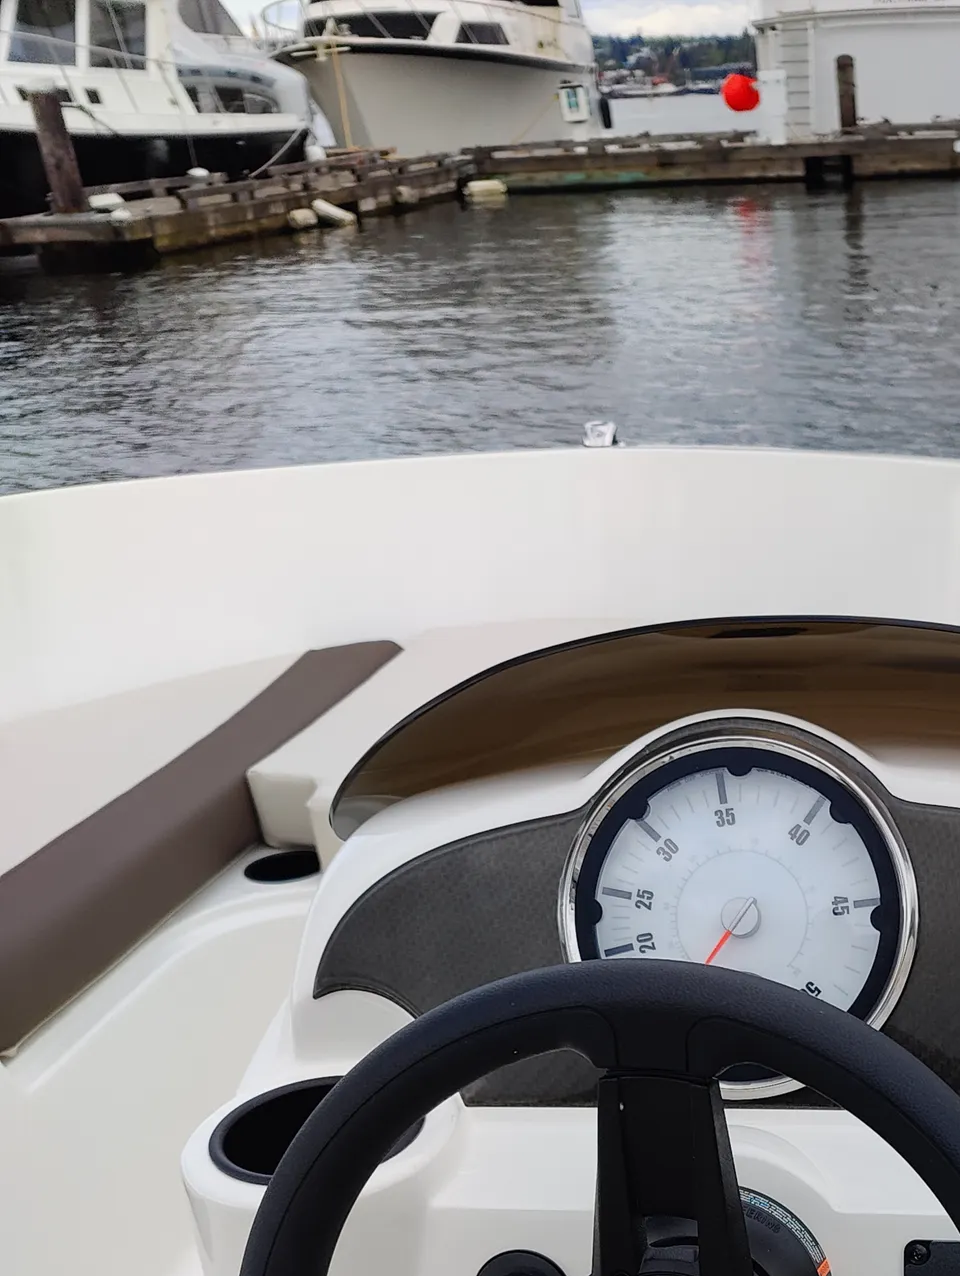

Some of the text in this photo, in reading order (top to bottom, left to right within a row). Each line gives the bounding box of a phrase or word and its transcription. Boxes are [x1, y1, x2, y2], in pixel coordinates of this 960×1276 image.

[714, 808, 736, 828] 35
[788, 824, 811, 847] 40
[656, 838, 679, 862] 30
[635, 888, 655, 911] 25
[831, 895, 850, 916] 45
[637, 932, 656, 954] 20
[801, 981, 822, 997] 5
